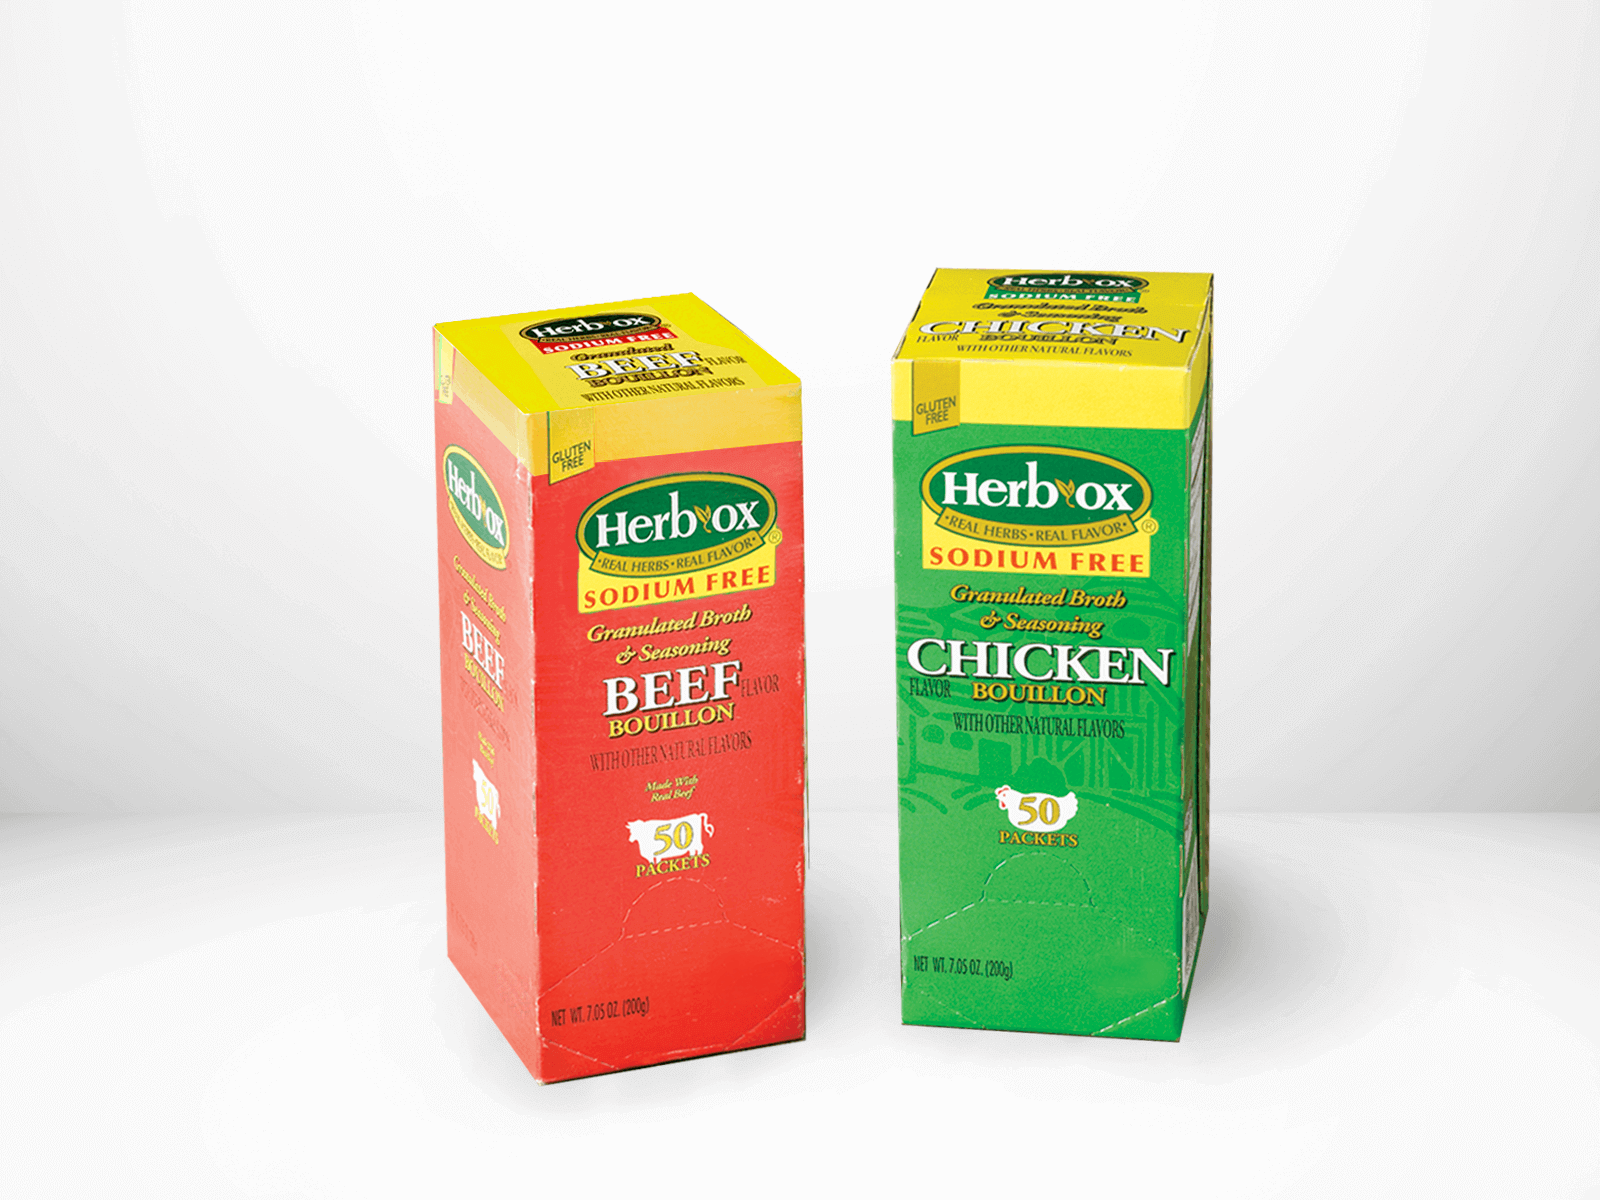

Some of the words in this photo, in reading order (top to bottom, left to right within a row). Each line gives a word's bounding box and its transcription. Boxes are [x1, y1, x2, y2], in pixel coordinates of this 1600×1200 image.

[1002, 275, 1083, 287] Herb
[1095, 279, 1135, 287] ox
[1085, 294, 1137, 303] FREE
[531, 319, 604, 337] Herb
[613, 316, 650, 326] ox
[917, 334, 959, 343] FLAVOR
[919, 320, 1191, 343] CHICKEN
[979, 334, 1118, 345] BOUILLON
[543, 338, 621, 354] SODIUM
[627, 332, 674, 343] FREE
[989, 345, 1030, 353] OTHER
[1030, 345, 1084, 355] NATURAL
[1081, 347, 1133, 357] FLAVORS
[565, 351, 703, 380] BEEF
[705, 355, 747, 366] FLAVOR
[585, 367, 714, 388] BOUILLON
[612, 385, 650, 399] OTHER
[650, 381, 701, 394] NATURAL
[697, 376, 745, 389] FLAVORS
[916, 396, 957, 415] GLUTEN
[925, 410, 949, 426] FREE
[552, 440, 591, 465] GLUTEN
[561, 455, 584, 473] FREE
[941, 461, 1059, 508] Herb
[1075, 482, 1133, 510] ox
[447, 458, 482, 521] Herb
[486, 506, 505, 546] ox
[595, 490, 698, 548] Herb
[711, 500, 760, 533] ox
[949, 515, 979, 533] REAL
[984, 525, 1028, 540] HERBS
[1036, 530, 1068, 541] REAL
[1072, 522, 1121, 540] FLAVOR
[601, 557, 628, 572] REAL
[631, 559, 669, 573] HERBS
[676, 554, 704, 569] REAL
[707, 541, 755, 563] FLAVOR
[930, 546, 1057, 570] SODIUM
[1070, 553, 1144, 573] FREE
[584, 577, 695, 609] SODIUM
[706, 565, 770, 591] FREE
[950, 584, 1067, 606] Granulated
[1067, 588, 1128, 609] Broth
[587, 611, 698, 642] Granulated
[699, 604, 753, 628] Broth
[979, 610, 1001, 629] &
[1003, 612, 1105, 639] Seasoning
[460, 611, 505, 690] BEEF
[616, 646, 637, 665] &
[638, 636, 732, 662] Seasoning
[907, 638, 1177, 687] CHICKEN
[602, 660, 742, 717] BEEF
[741, 674, 780, 698] FLAVOR
[909, 678, 951, 698] FLAVOR
[971, 681, 1107, 707] BOUILLON
[608, 702, 735, 739] BOUILLON
[953, 712, 983, 731] WITH
[985, 713, 1024, 733] OTHER
[1025, 715, 1075, 736] NATURAL
[1077, 718, 1125, 739] FLAVORS
[590, 751, 620, 771] WITH
[621, 746, 658, 768] OTHER
[659, 738, 706, 762] NATURAL
[708, 730, 753, 754] FLAVORS
[644, 778, 673, 792] Made
[650, 789, 673, 803] Real
[673, 785, 696, 800] Beef
[1017, 796, 1060, 825] 50
[653, 821, 694, 856] 50
[998, 830, 1079, 848] PACKETS
[635, 853, 711, 878] PACKETS
[914, 955, 928, 972] NET
[949, 957, 968, 975] 7.05
[985, 960, 1013, 981] (200g)
[551, 1009, 566, 1026] NET
[587, 1002, 605, 1021] 7.05
[622, 996, 649, 1017] (200g)
